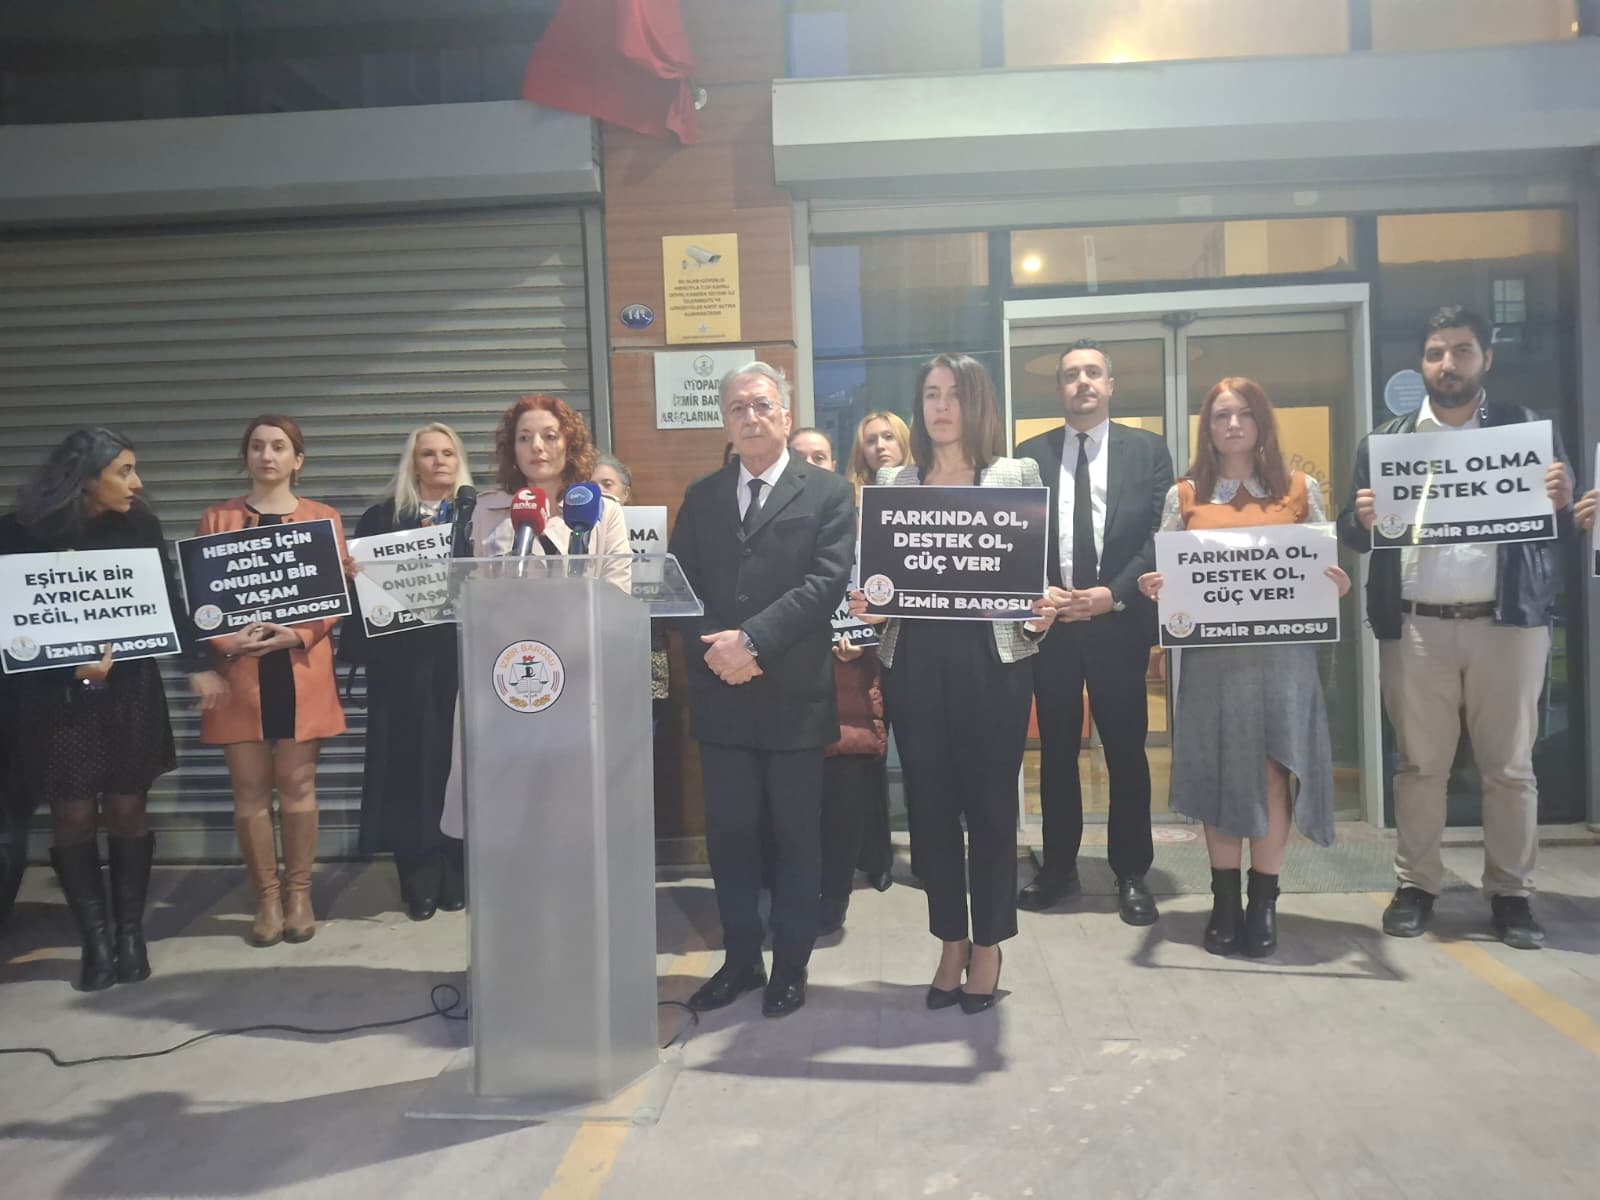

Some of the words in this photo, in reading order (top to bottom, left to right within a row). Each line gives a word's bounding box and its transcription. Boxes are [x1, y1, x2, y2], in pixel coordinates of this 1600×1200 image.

[702, 395, 720, 406] BAR
[1381, 459, 1458, 477] ENGEL
[1466, 451, 1541, 472] OLMA
[1393, 481, 1488, 501] DESTEK
[1496, 478, 1531, 495] OL
[512, 499, 538, 510] anka
[881, 511, 988, 527] FARKINDA
[993, 512, 1029, 530] OL,
[1466, 520, 1545, 536] BAROSU
[630, 528, 659, 541] MA
[894, 533, 974, 549] DESTEK
[978, 534, 1014, 552] OL,
[203, 538, 273, 559] HERKES
[276, 531, 312, 549] İÇİN
[373, 538, 436, 558] HERKES
[226, 556, 269, 573] ADİL
[274, 551, 296, 564] VE
[904, 551, 947, 575] GÜÇ
[952, 556, 1001, 572] VER!
[1178, 548, 1280, 566] FARKINDA
[1286, 546, 1318, 560] OL,
[25, 570, 97, 587] EŞİTLİK
[104, 566, 134, 583] BİR
[210, 569, 284, 592] ONURLU
[288, 563, 318, 580] BİR
[382, 572, 447, 591] ONURLU
[1192, 568, 1267, 584] DESTEK
[1274, 567, 1305, 582] OL,
[33, 586, 134, 606] AYRICALIK
[234, 585, 299, 605] YAŞAM
[898, 592, 950, 609] İZMİR
[955, 598, 1033, 611] BAROSU
[1203, 587, 1244, 605] GÜÇ
[1250, 587, 1295, 601] VER!
[13, 607, 79, 628] DEĞİL,
[84, 603, 157, 621] HAKTIR!
[227, 610, 273, 627] İZMİR
[276, 599, 341, 618] BAROSU
[1200, 623, 1249, 638] İZMİR
[1254, 622, 1329, 636] BAROSU
[46, 643, 96, 659] İZMİR
